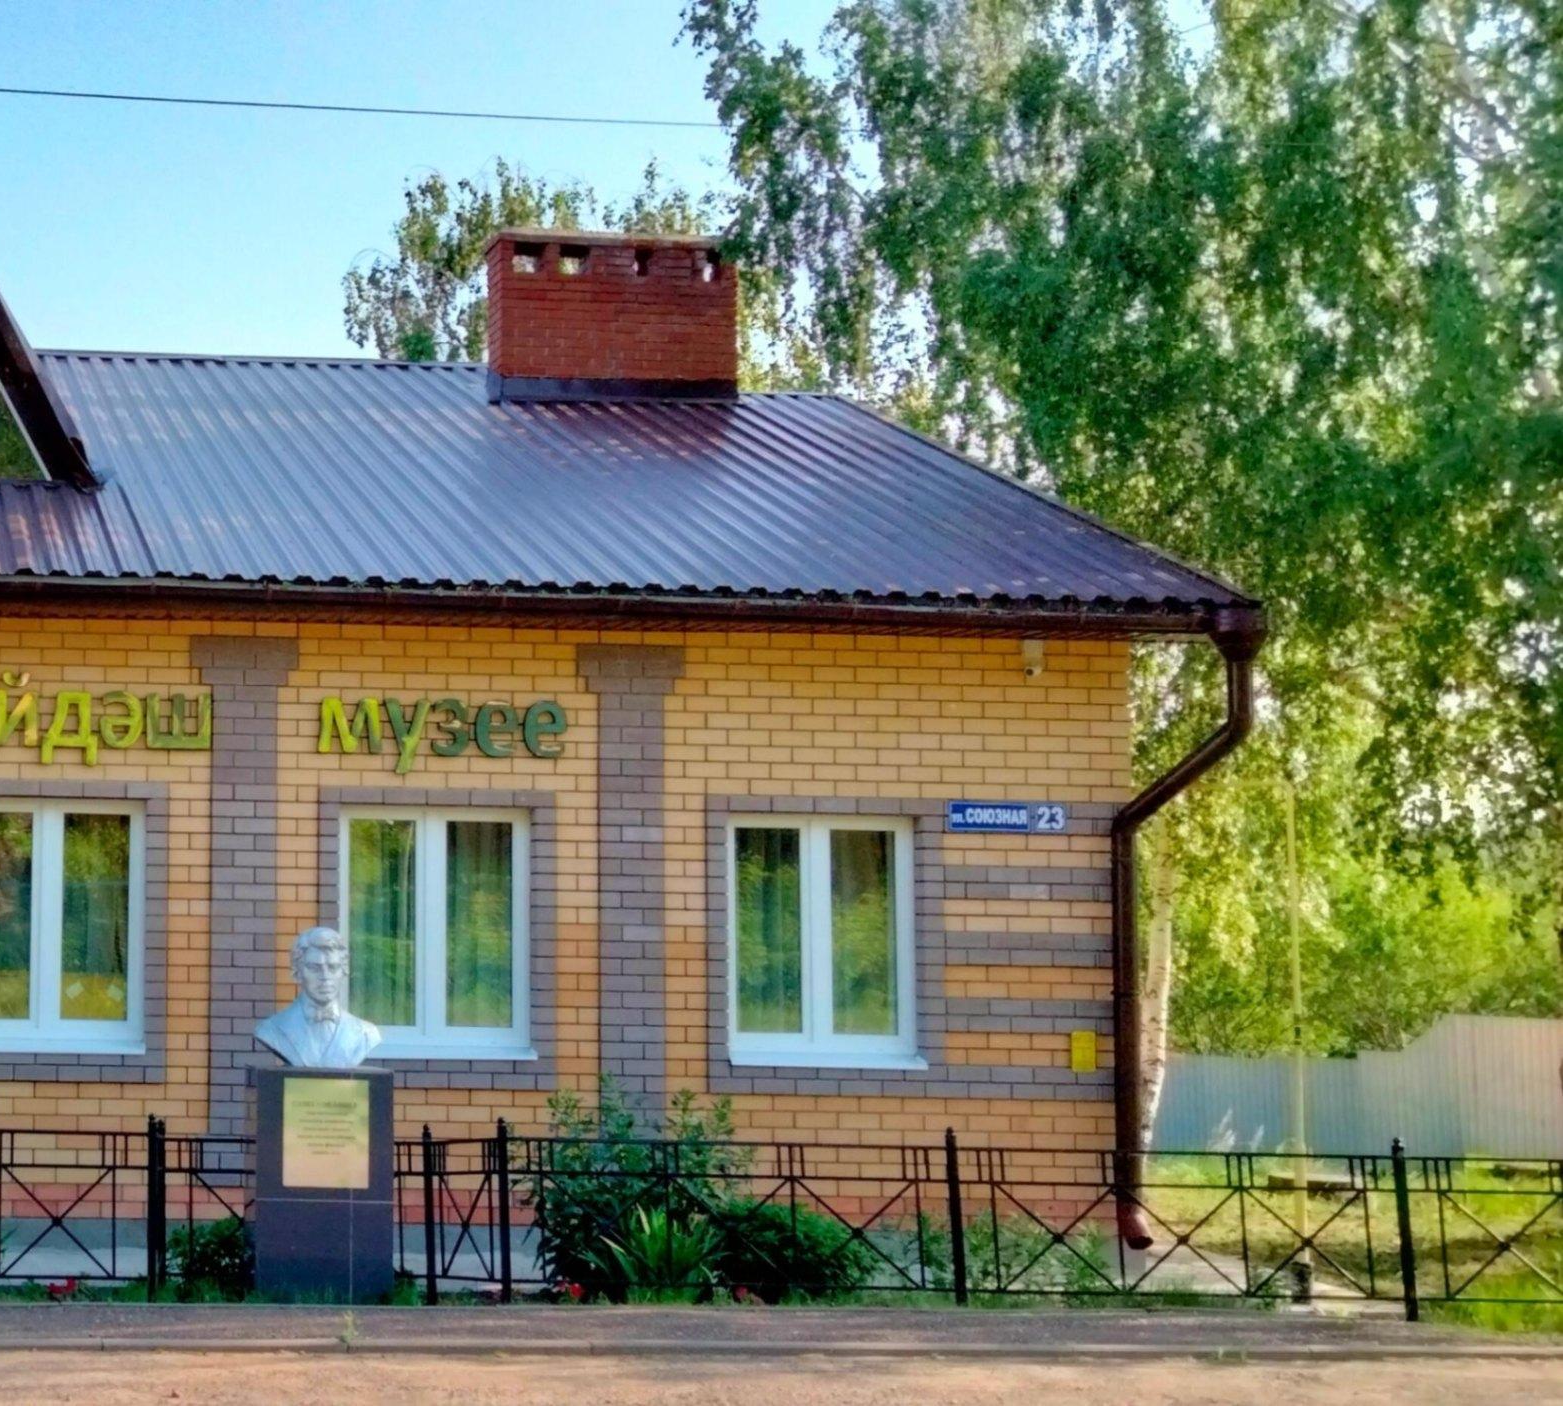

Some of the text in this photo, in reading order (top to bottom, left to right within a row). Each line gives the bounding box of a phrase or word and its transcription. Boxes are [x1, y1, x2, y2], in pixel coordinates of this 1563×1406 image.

[317, 696, 569, 775] музее
[965, 808, 1028, 825] СОЮЗНАЯ
[1037, 806, 1066, 830] 23
